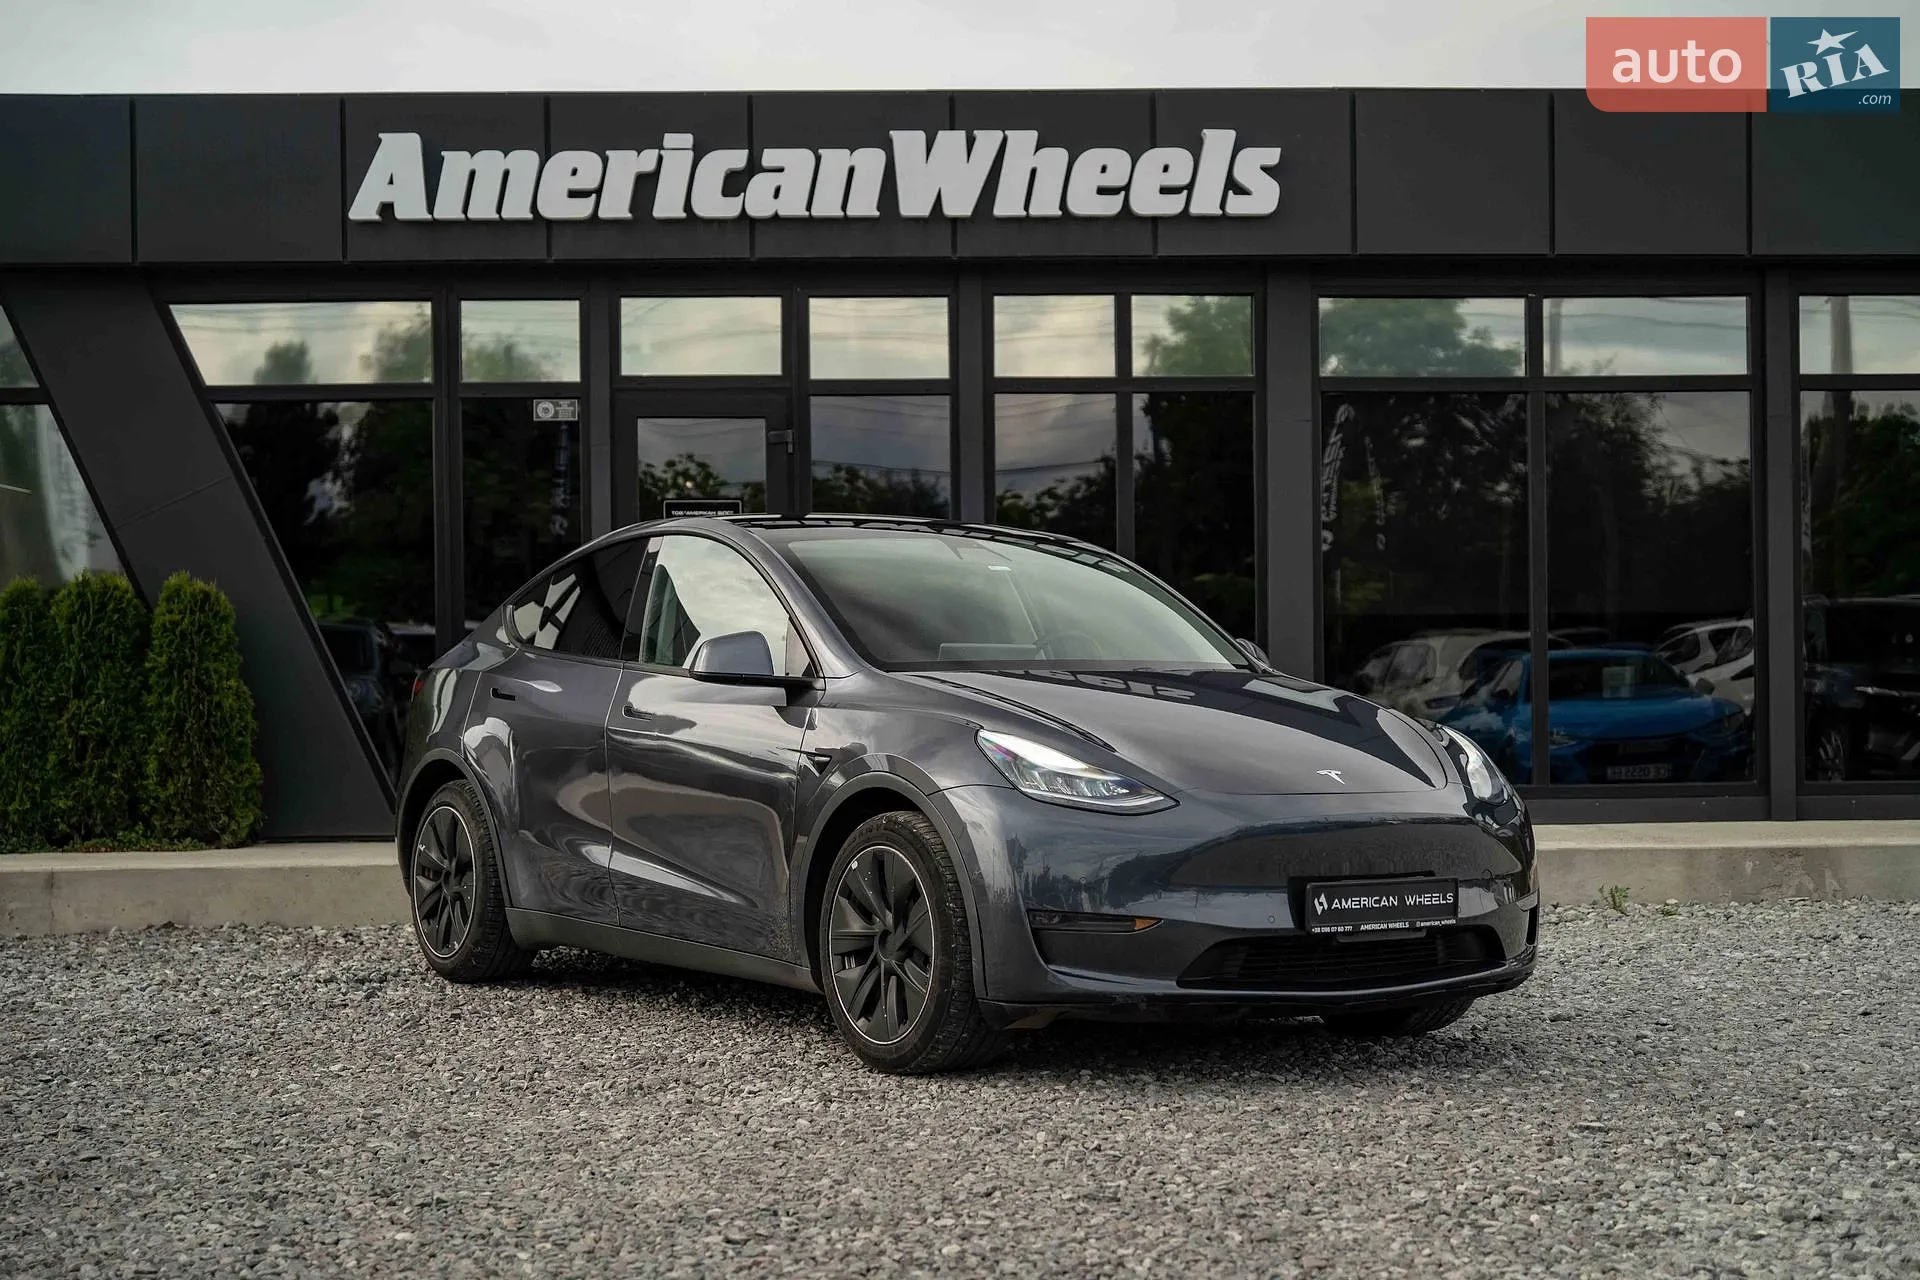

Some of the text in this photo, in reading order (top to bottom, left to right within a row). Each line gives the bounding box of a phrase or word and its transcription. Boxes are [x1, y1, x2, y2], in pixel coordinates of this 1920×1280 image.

[348, 129, 1282, 222] AmericanWheels
[1331, 892, 1454, 910] AMERICAN WHEELS
[1360, 921, 1410, 931] AMERICAN WHEELS
